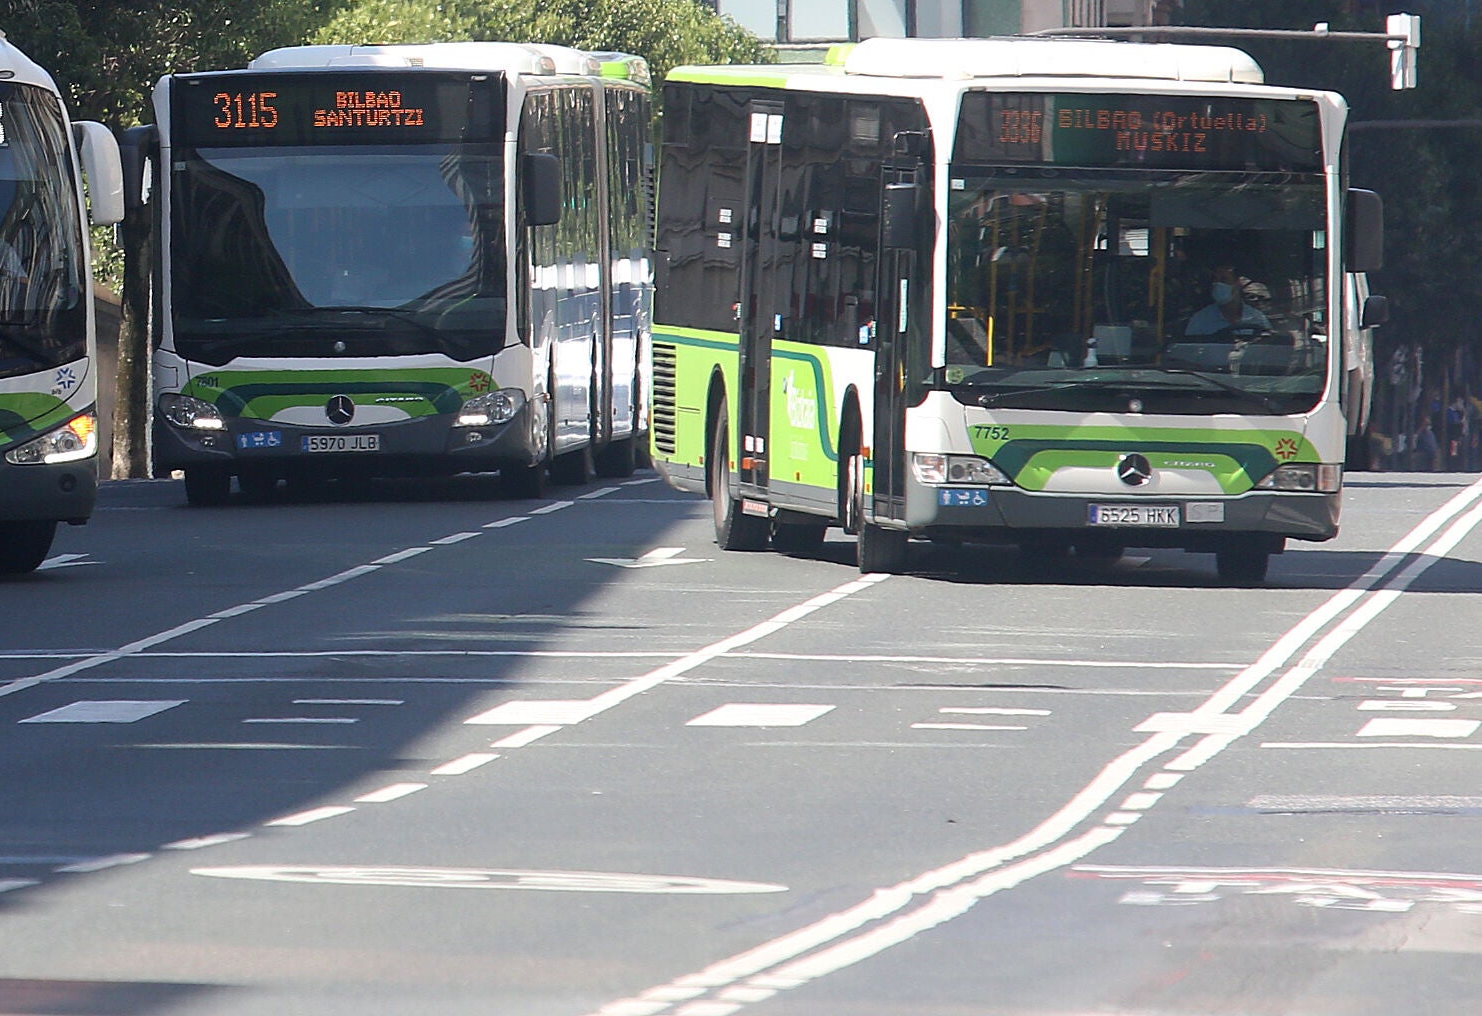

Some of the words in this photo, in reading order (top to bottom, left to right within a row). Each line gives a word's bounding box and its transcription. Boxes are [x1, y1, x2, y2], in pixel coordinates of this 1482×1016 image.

[336, 90, 402, 108] BILBAO
[213, 91, 278, 128] 3115
[314, 108, 424, 127] SANTURTZI
[1058, 109, 1143, 131] BILBAO
[1116, 131, 1207, 152] MUSKIZ
[974, 426, 1010, 441] 7752
[311, 437, 346, 451] 5970
[351, 436, 377, 450] JLB
[1101, 507, 1140, 523] 6525
[1147, 507, 1177, 524] HKK
